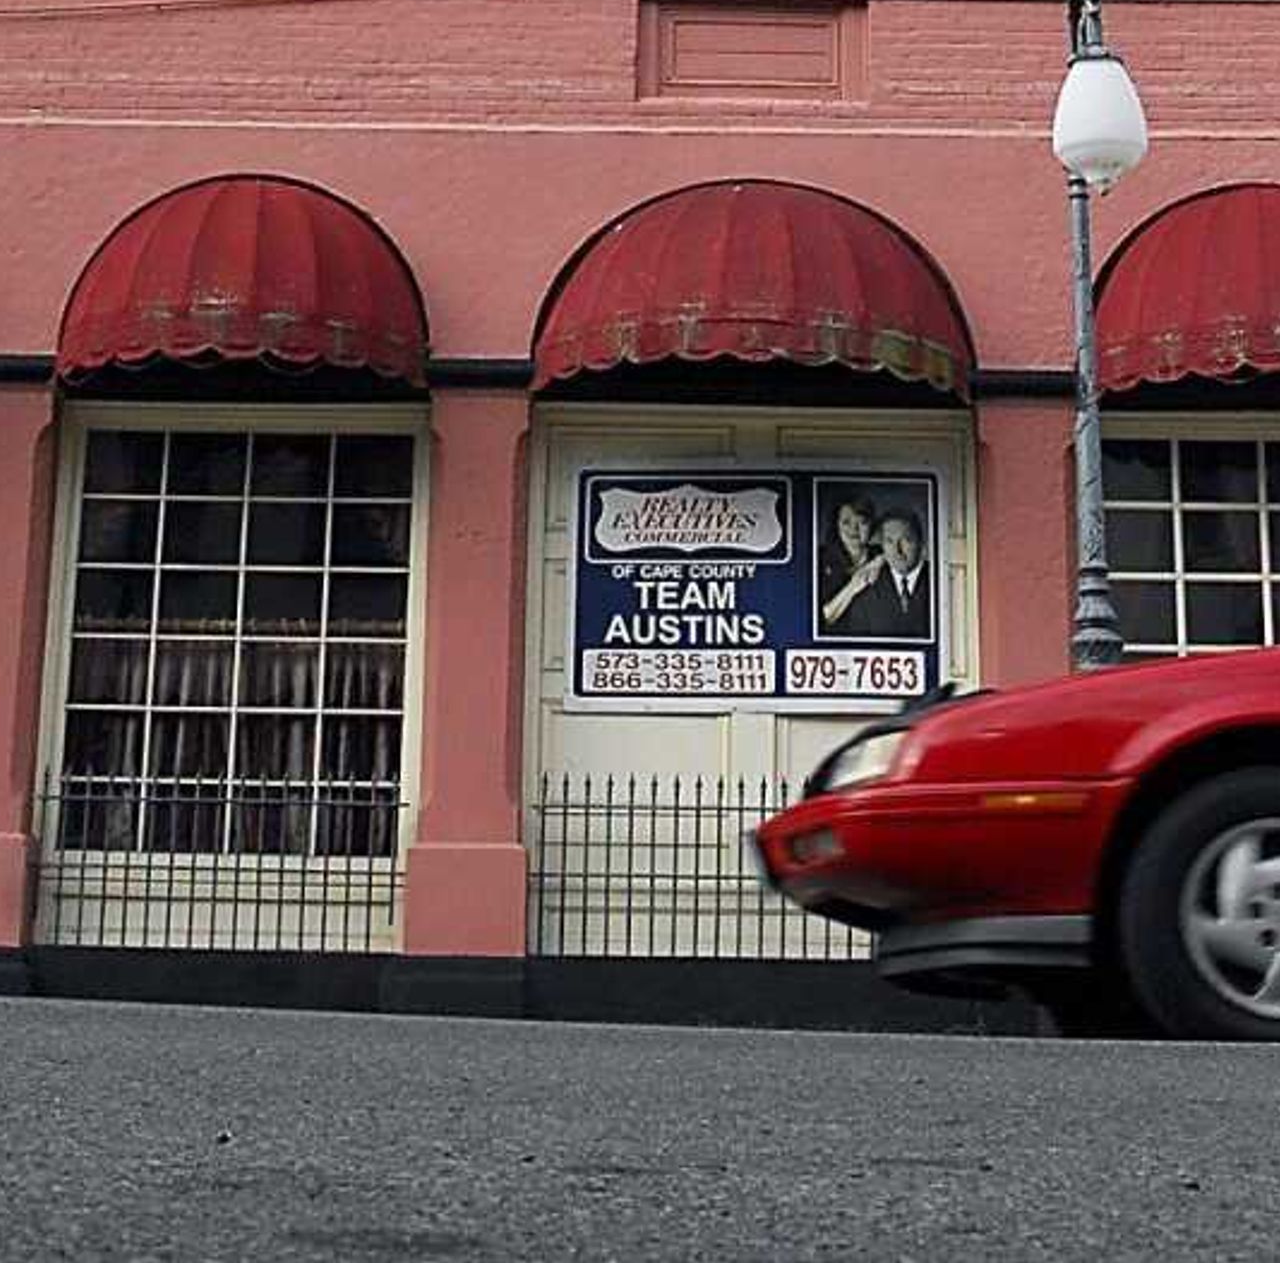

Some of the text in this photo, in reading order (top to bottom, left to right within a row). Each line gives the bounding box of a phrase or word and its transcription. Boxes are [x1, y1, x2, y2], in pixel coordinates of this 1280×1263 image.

[642, 496, 737, 513] REALTY
[612, 512, 758, 529] EXECUTIVES
[611, 564, 756, 579] OF CAPE COUNTY
[634, 581, 736, 610] TEAM
[604, 614, 766, 645] AUSTINS
[596, 653, 766, 671] 573-335-8111
[593, 672, 768, 690] 866-335-8111
[790, 655, 919, 690] 979-7653
